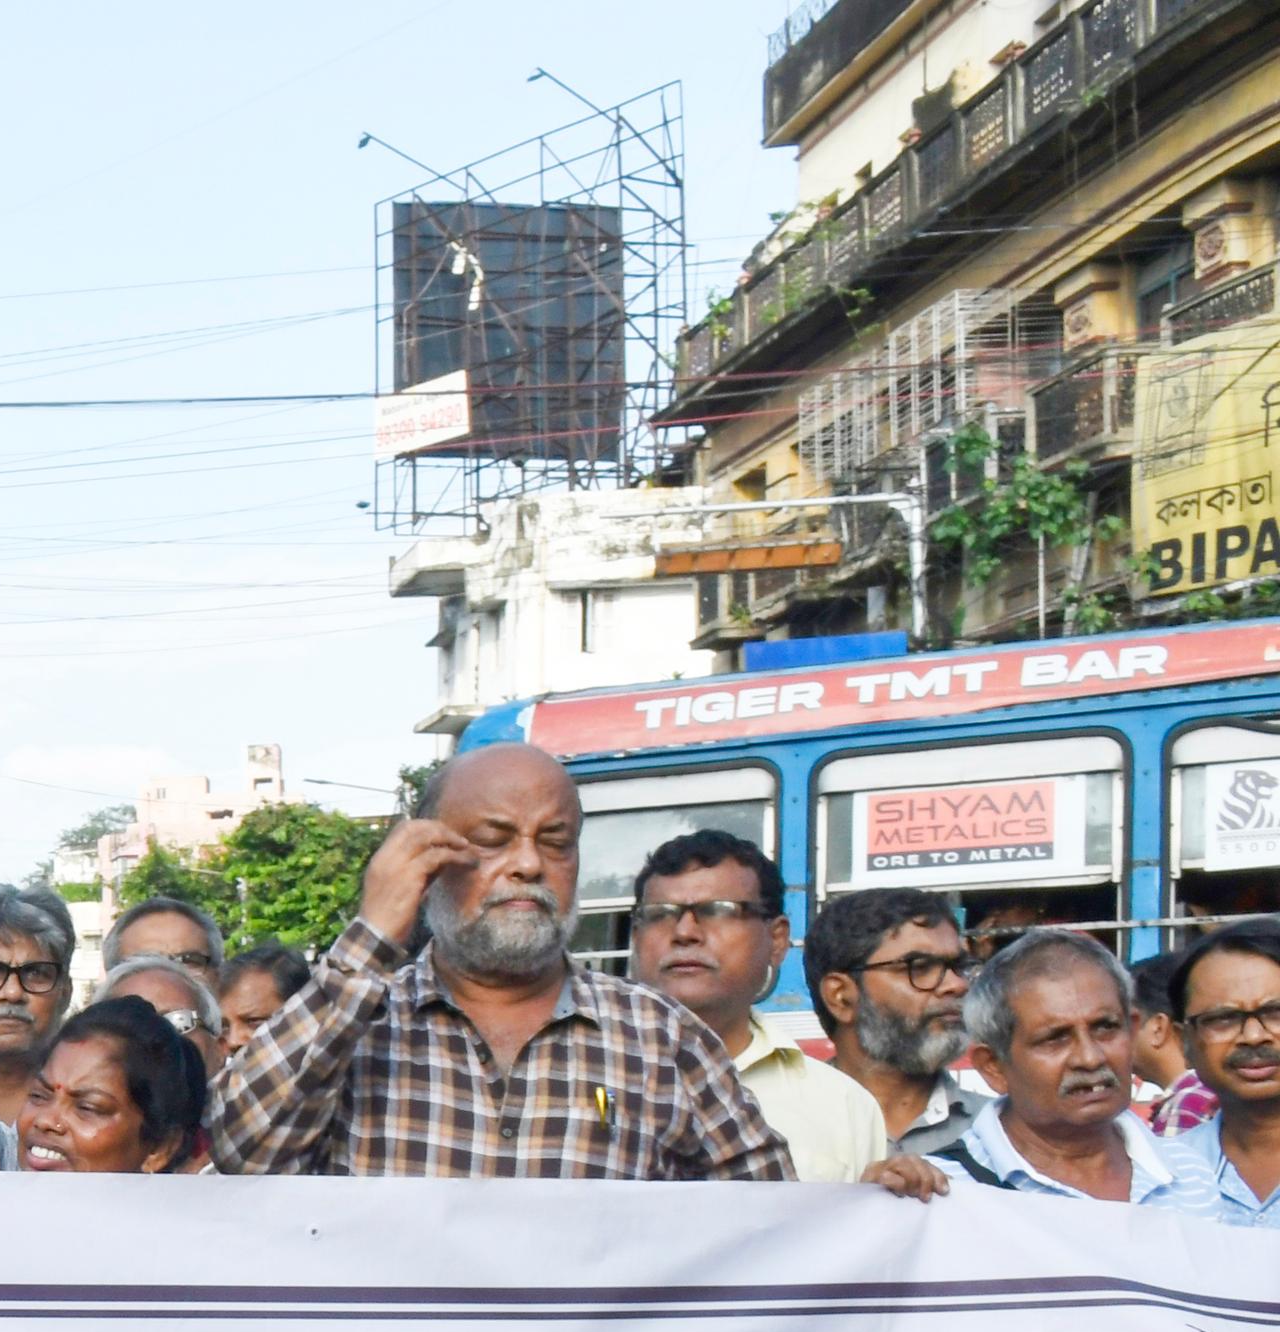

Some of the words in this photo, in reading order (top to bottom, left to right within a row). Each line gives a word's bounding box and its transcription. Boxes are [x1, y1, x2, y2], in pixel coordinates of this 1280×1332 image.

[1156, 471, 1273, 525] কলকাতা
[635, 681, 824, 729] TIGER
[846, 661, 998, 703] TMT
[1020, 645, 1169, 687] BAR
[875, 790, 1046, 824] SHYAM
[874, 818, 1048, 846] METALICS
[872, 854, 919, 868] ORE
[929, 851, 959, 864] TO
[970, 846, 1047, 862] METAL
